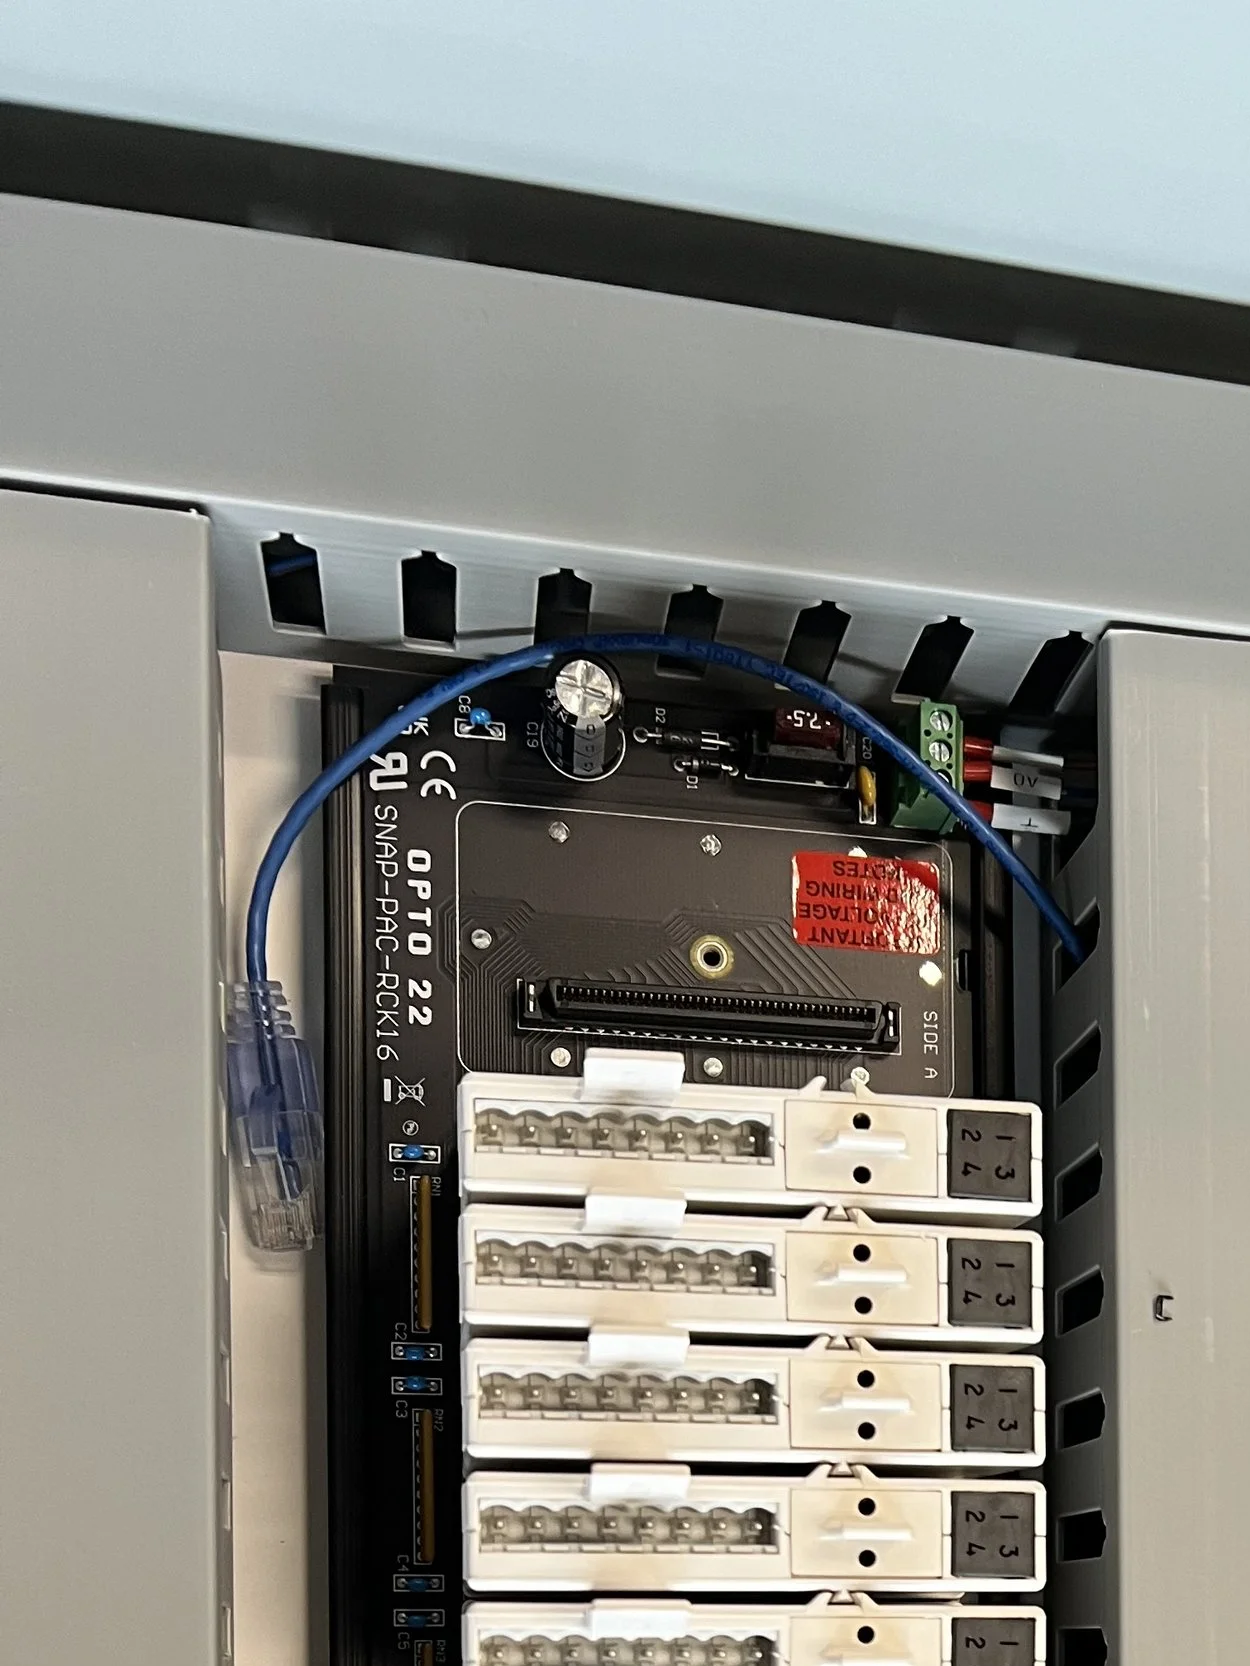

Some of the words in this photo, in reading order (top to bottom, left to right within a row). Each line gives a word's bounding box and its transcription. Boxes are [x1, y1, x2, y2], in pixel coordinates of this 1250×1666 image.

[458, 695, 471, 714] C8
[655, 707, 666, 724] D2
[527, 722, 539, 748] C19
[420, 750, 457, 800] CE
[407, 849, 432, 955] OPTO
[374, 804, 400, 1061] SNAP-PAC-RCK16
[408, 979, 433, 1026] 22
[924, 1011, 938, 1055] SIDE
[924, 1067, 938, 1079] A
[961, 1128, 982, 1142] 2
[393, 1167, 406, 1182] C1
[961, 1162, 981, 1177] 4
[995, 1166, 1015, 1180] 3
[961, 1257, 981, 1270] 2
[962, 1290, 982, 1304] 4
[995, 1293, 1015, 1306] 3
[395, 1322, 407, 1341] C2
[964, 1383, 984, 1396] 2
[395, 1400, 408, 1419] C3
[966, 1416, 985, 1430] 4
[998, 1419, 1018, 1431] 3
[966, 1510, 985, 1523] 2
[966, 1542, 986, 1556] 4
[999, 1545, 1019, 1558] 3
[398, 1632, 410, 1650] C5
[965, 1637, 985, 1649] 2
